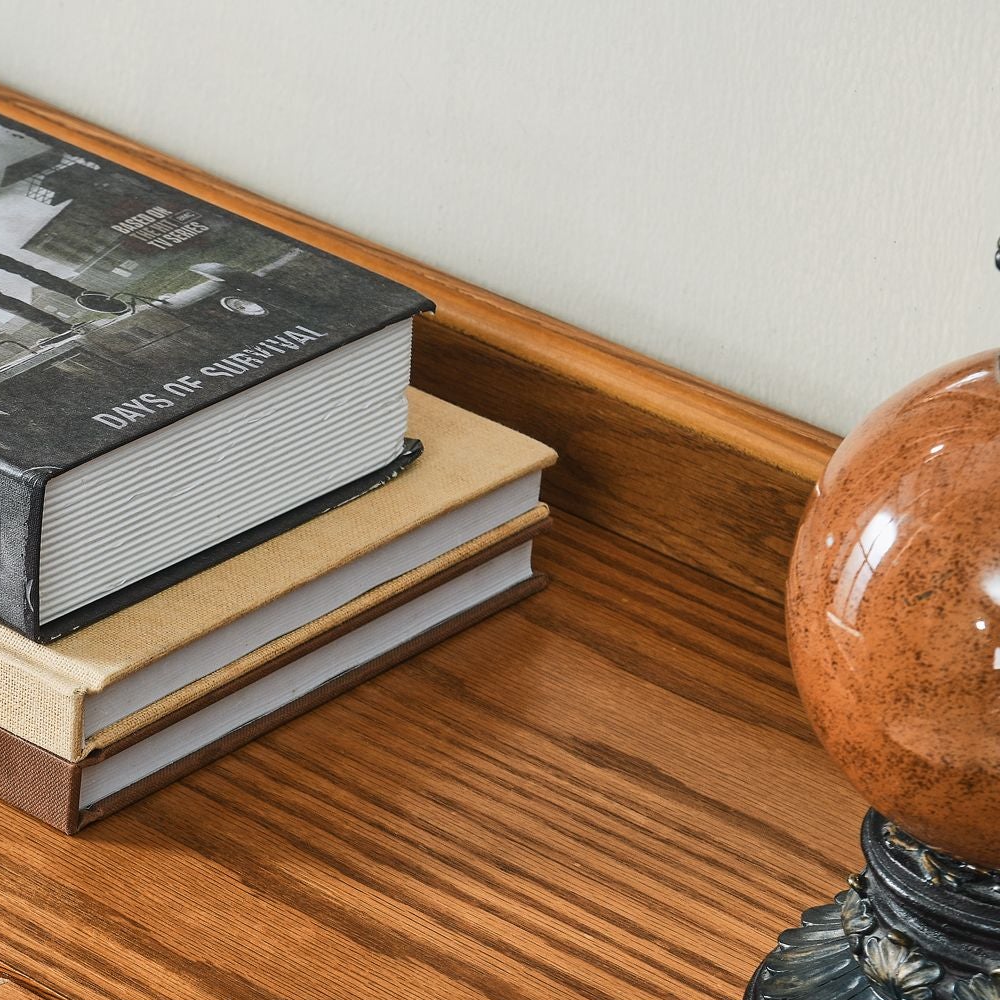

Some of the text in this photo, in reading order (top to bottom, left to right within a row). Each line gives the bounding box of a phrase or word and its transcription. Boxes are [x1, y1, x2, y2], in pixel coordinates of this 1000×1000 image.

[111, 205, 174, 234] BASED ON
[128, 226, 160, 242] THE
[146, 221, 210, 250] TV SERIES
[92, 324, 329, 430] DAYS OF SURVIVAL
